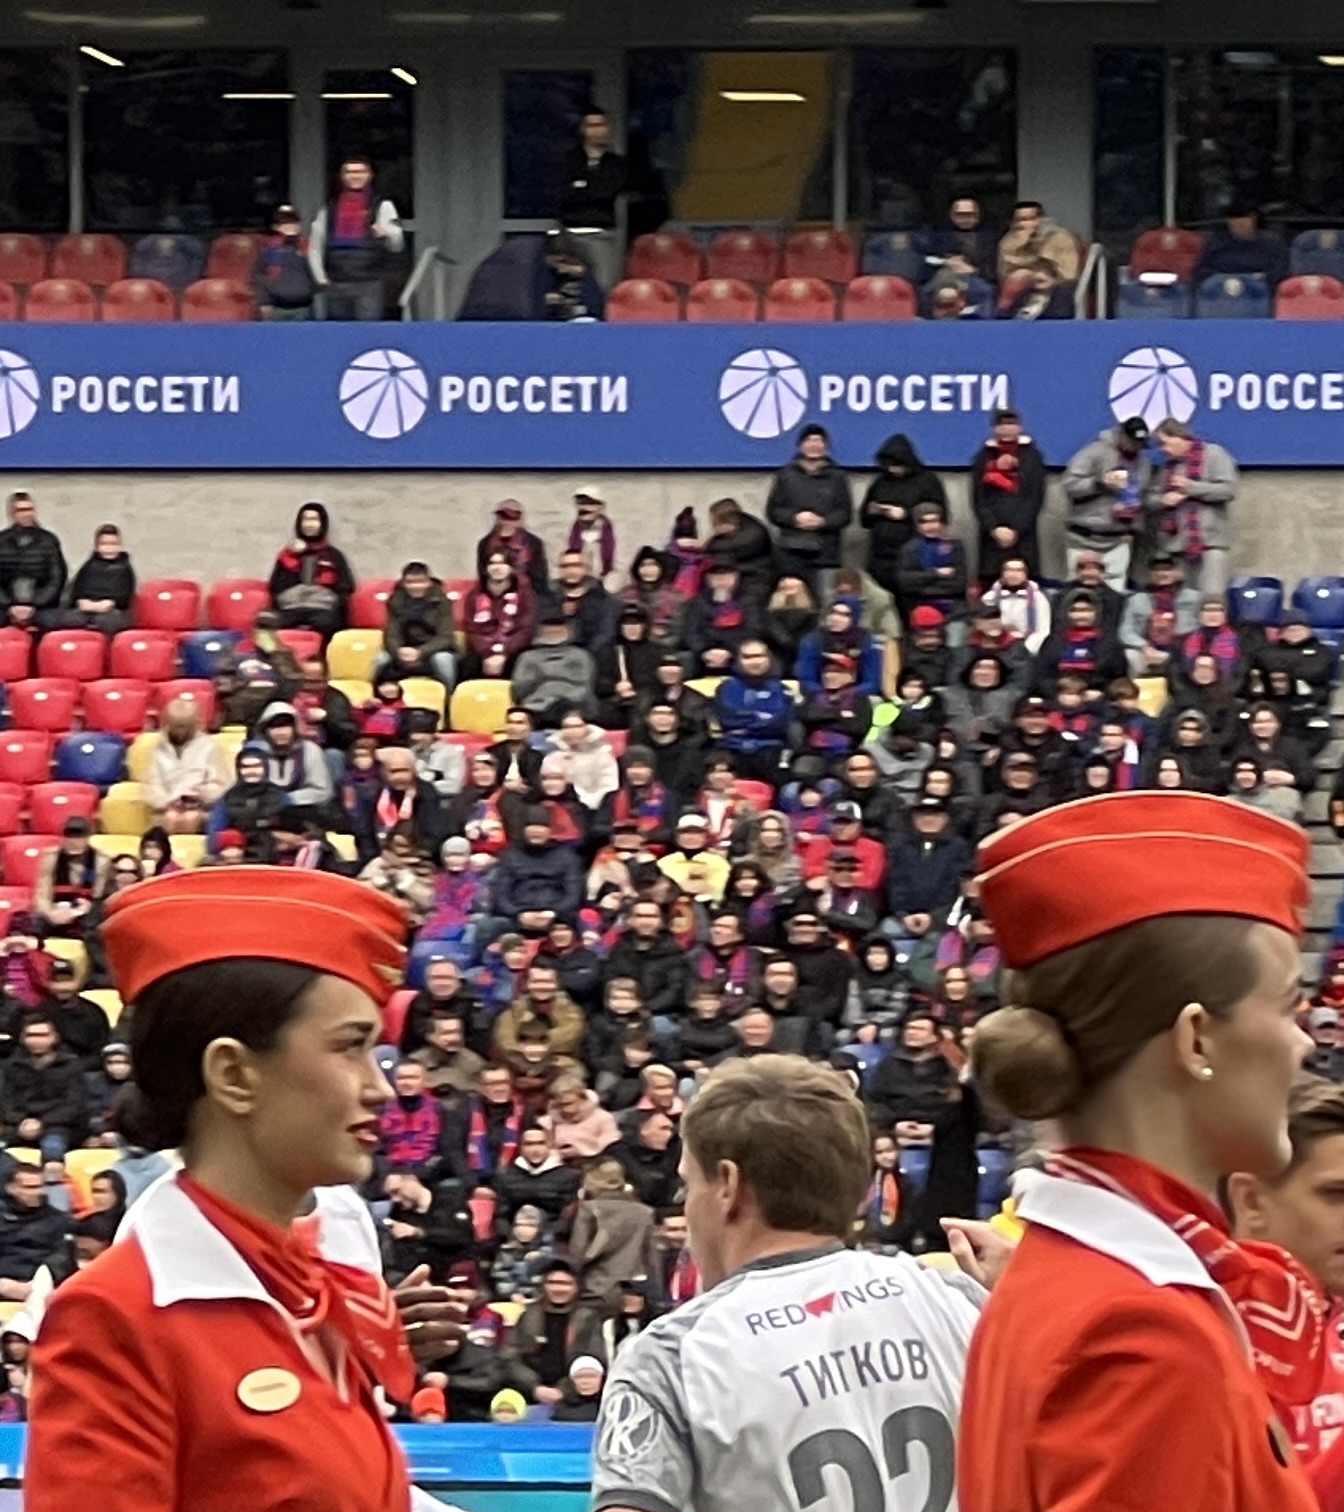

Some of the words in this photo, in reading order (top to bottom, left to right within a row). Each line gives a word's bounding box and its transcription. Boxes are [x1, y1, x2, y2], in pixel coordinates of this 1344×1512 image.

[51, 375, 239, 413] РОССЕТИ
[440, 375, 628, 413] РОССЕТИ
[820, 374, 1009, 412] РОССЕТИ
